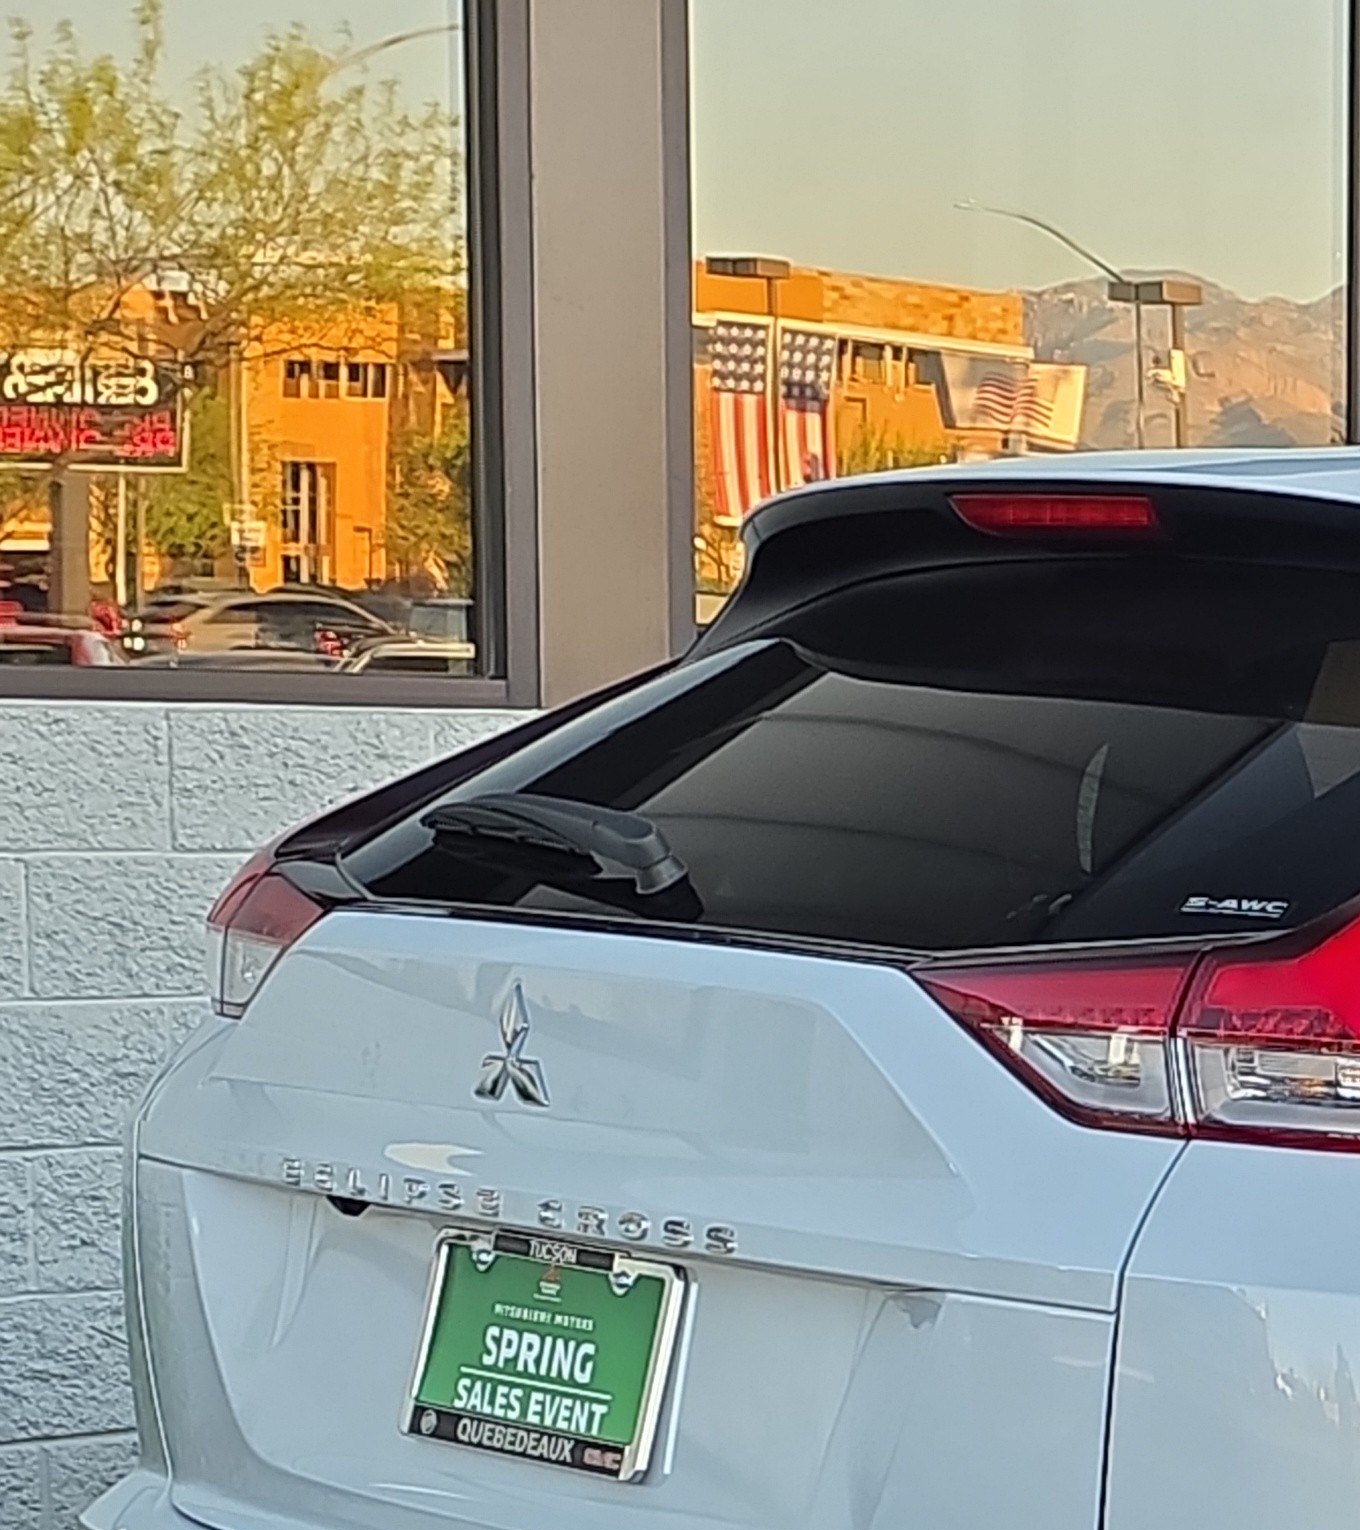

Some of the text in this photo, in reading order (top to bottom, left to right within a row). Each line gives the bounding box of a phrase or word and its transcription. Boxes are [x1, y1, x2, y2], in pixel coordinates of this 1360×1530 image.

[1184, 896, 1289, 914] S-AWC
[283, 1156, 739, 1255] ECLIPSE CROSS
[528, 1240, 578, 1265] TUCSON
[481, 1325, 597, 1385] SPRING
[452, 1378, 609, 1436] SALES EVENT
[456, 1418, 575, 1463] QUEBEDEAUX
